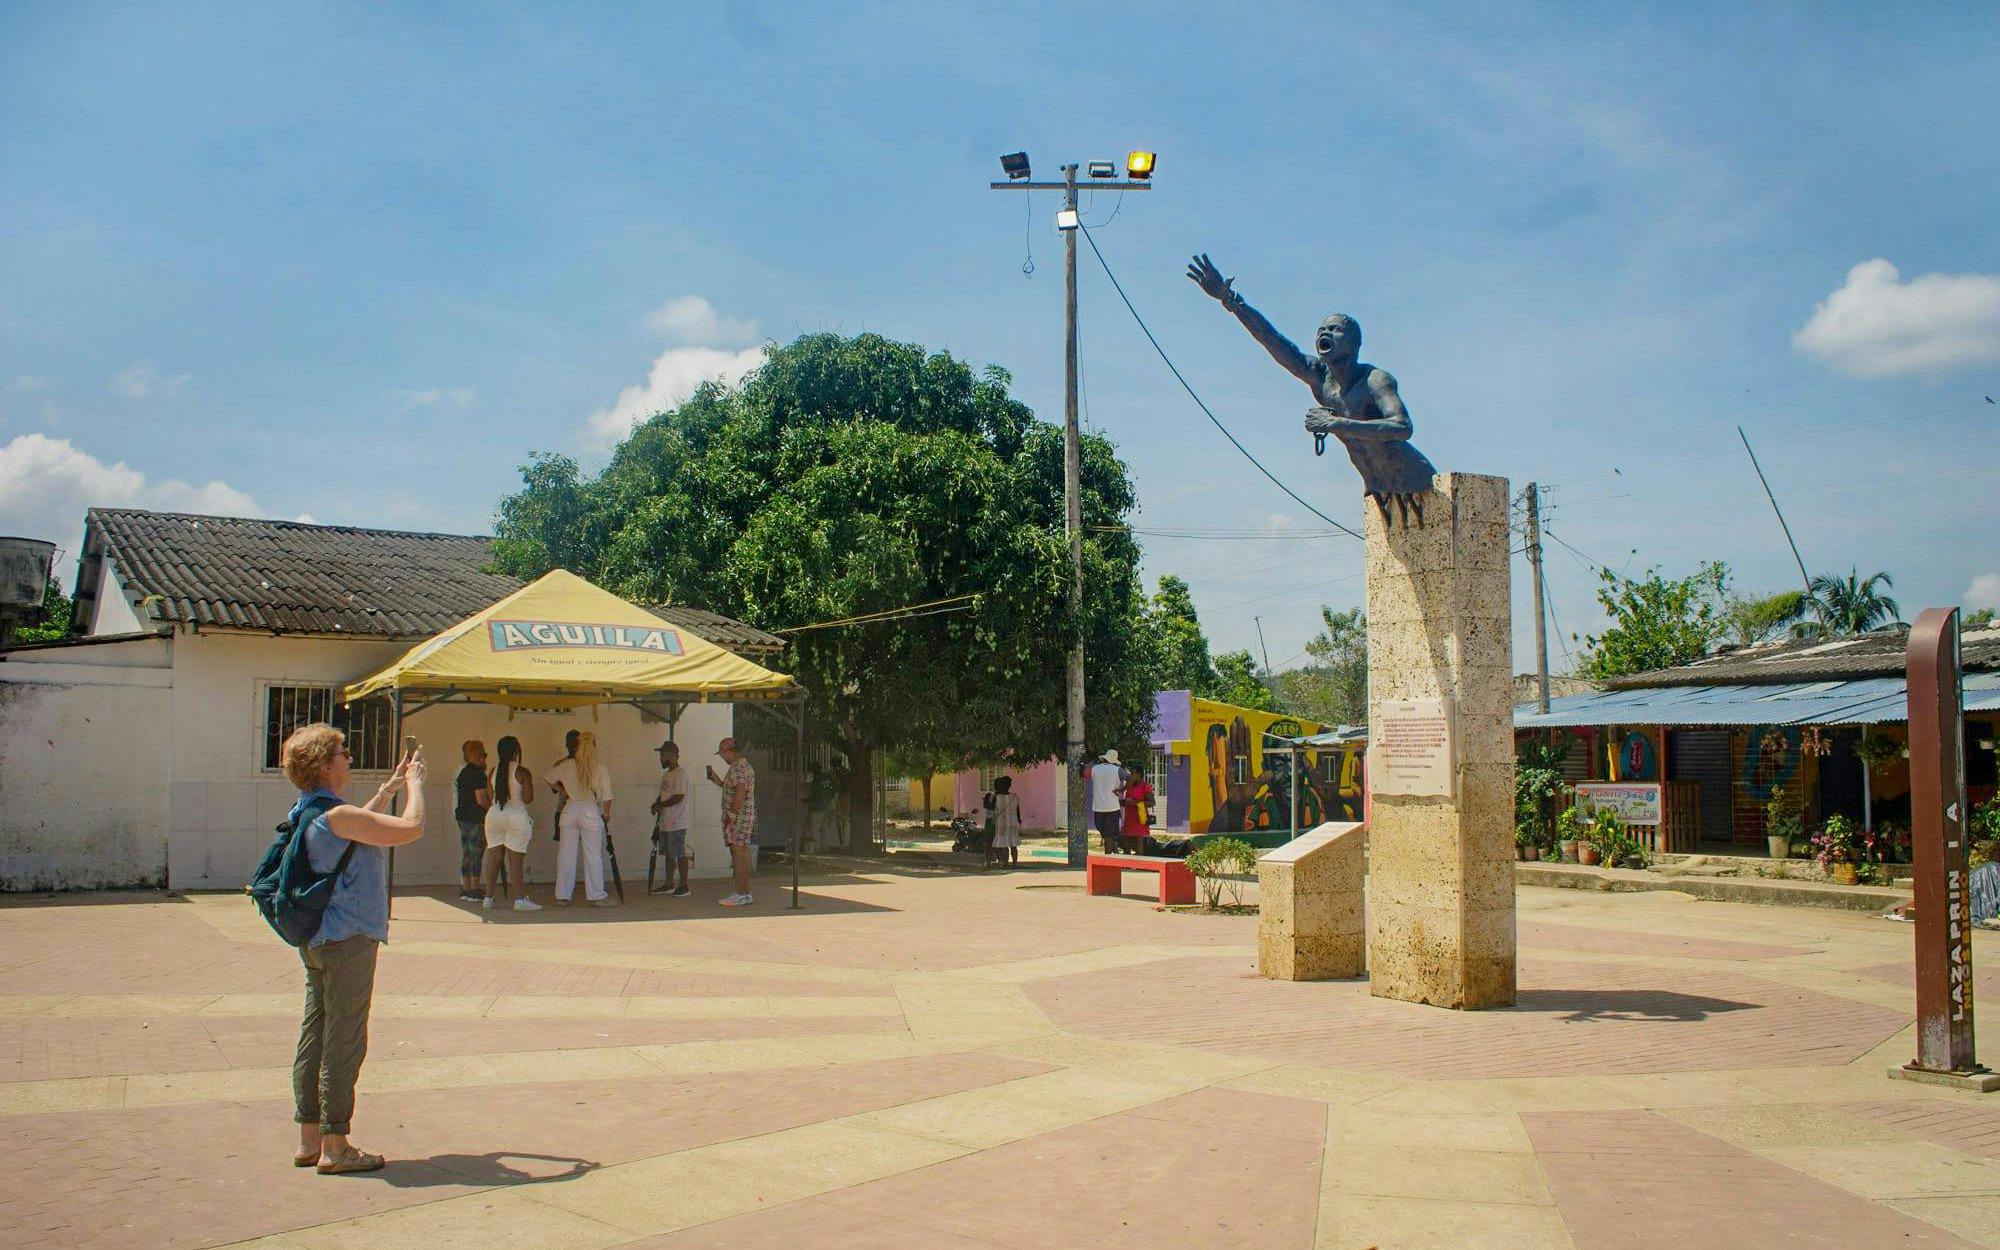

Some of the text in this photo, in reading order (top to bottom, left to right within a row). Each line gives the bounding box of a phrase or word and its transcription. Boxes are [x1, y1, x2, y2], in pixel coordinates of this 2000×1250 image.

[503, 624, 667, 650] AGUILA
[549, 658, 575, 666] igual
[584, 658, 623, 667] siempre
